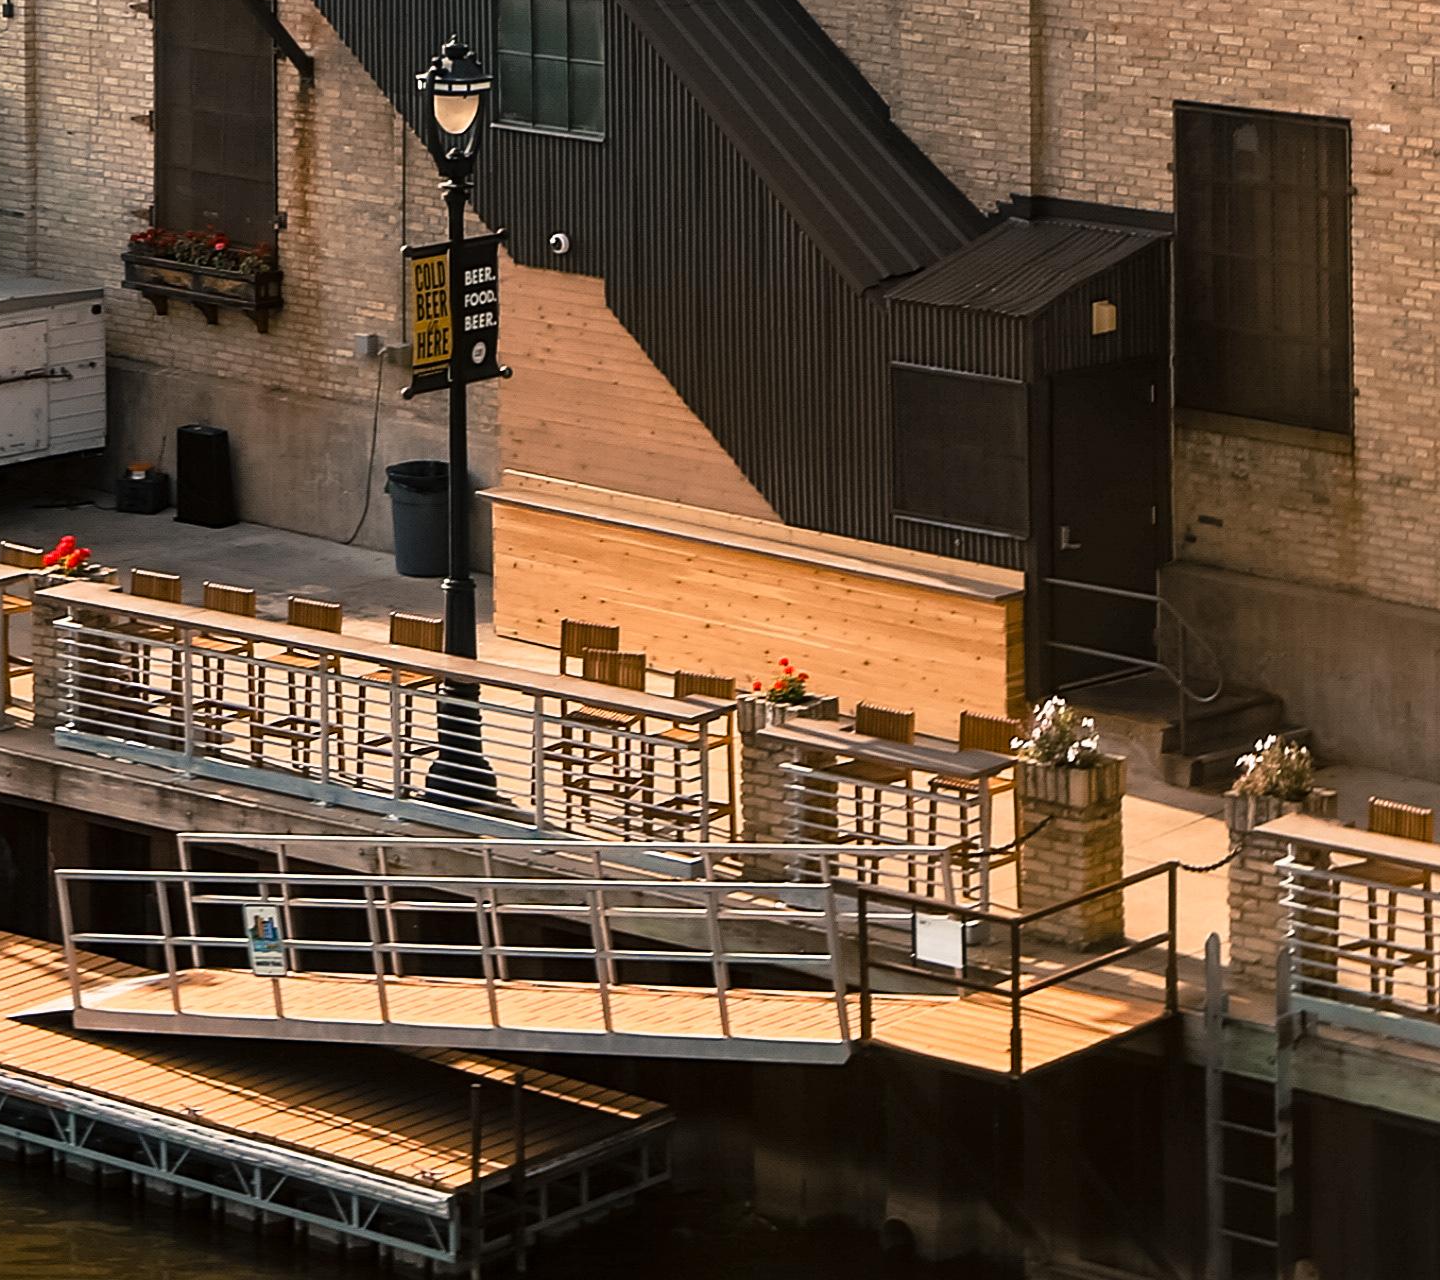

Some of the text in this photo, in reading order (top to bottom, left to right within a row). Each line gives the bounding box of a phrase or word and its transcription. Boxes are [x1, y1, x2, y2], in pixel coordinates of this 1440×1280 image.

[415, 261, 445, 291] COLD
[464, 266, 496, 286] BEER.
[416, 290, 448, 322] BEER
[464, 290, 497, 308] FOOD.
[464, 312, 497, 332] BEER.
[417, 327, 449, 359] HERE
